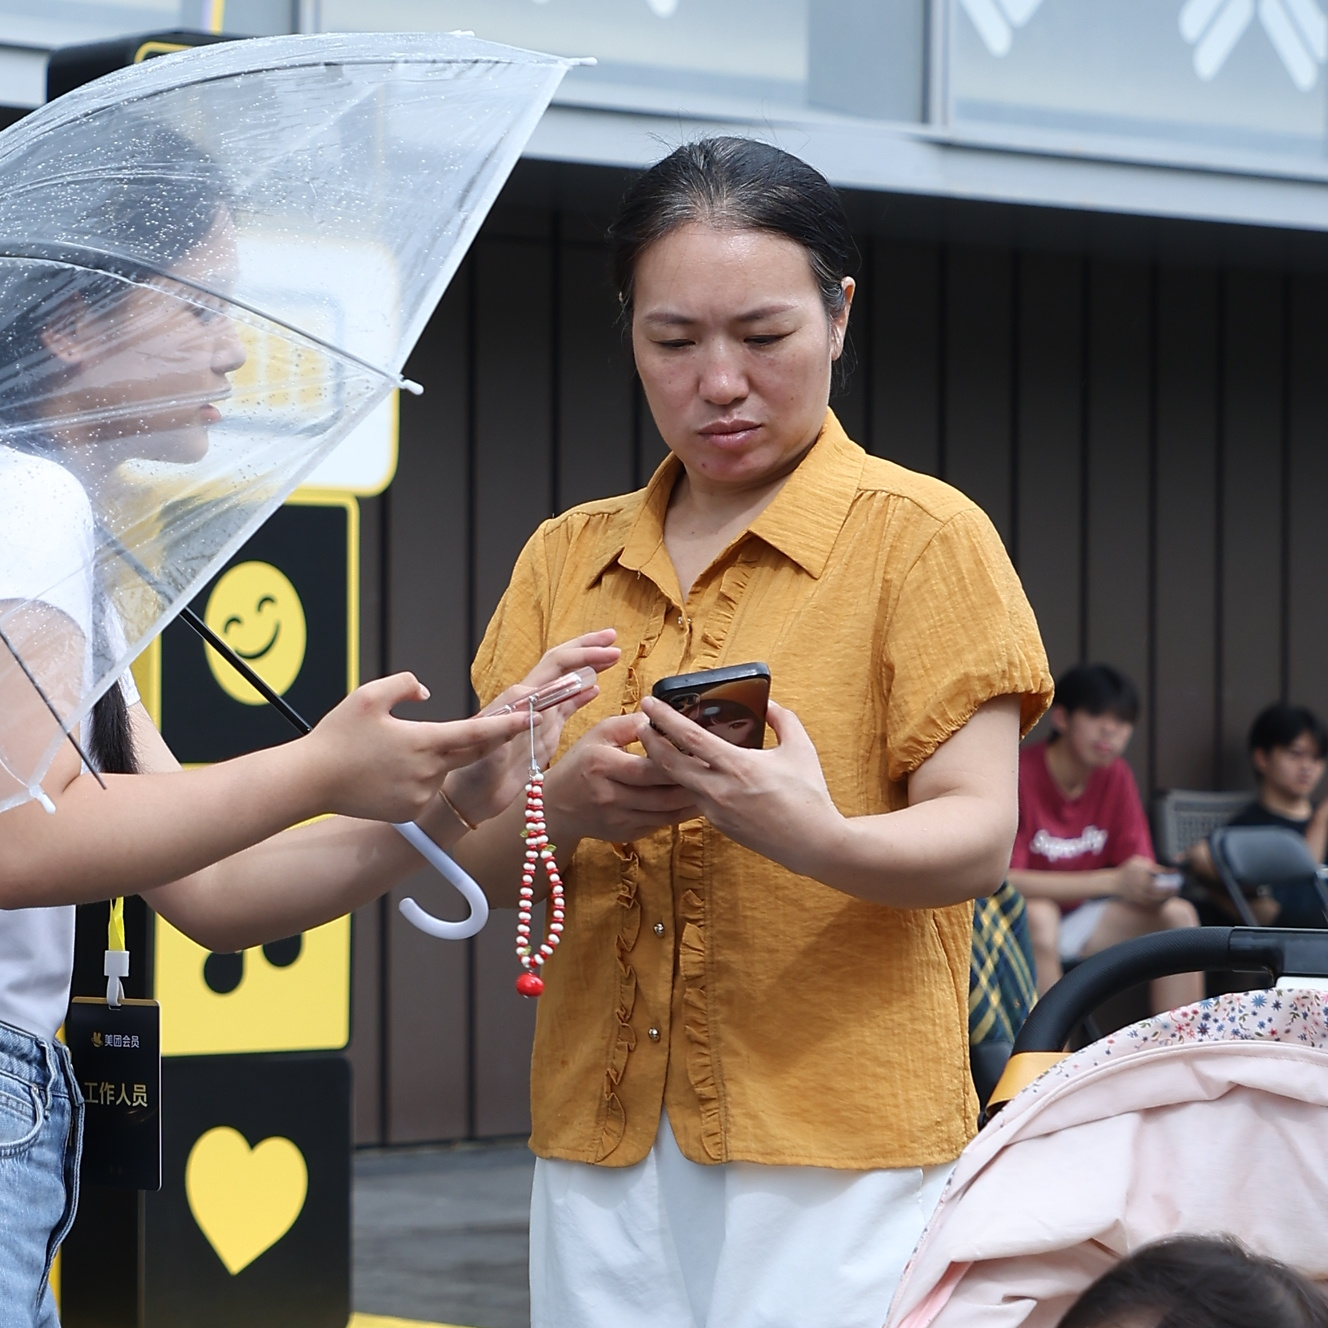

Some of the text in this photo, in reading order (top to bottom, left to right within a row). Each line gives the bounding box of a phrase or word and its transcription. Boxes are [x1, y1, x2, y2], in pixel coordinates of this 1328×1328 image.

[104, 1033, 141, 1049] 美团会员
[83, 1081, 149, 1108] 工作人员
